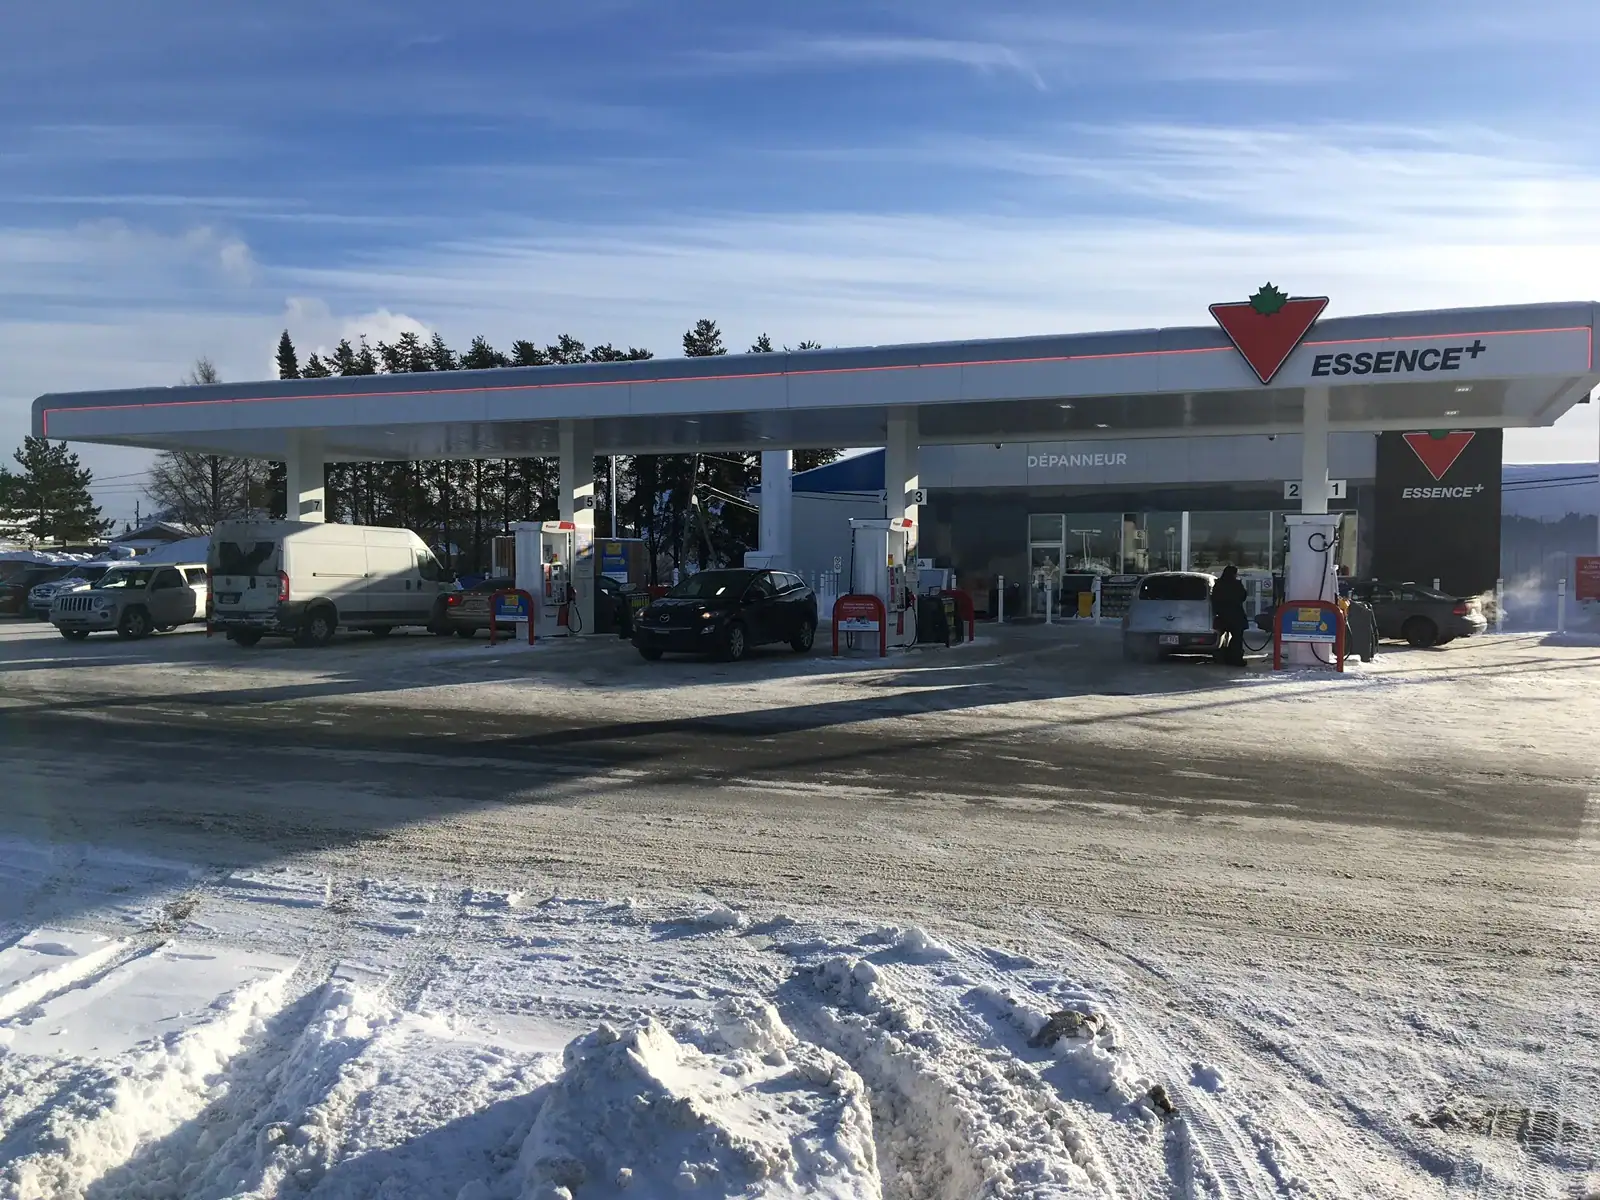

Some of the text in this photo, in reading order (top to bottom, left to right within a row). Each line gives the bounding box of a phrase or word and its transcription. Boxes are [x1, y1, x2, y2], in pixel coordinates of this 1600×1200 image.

[1027, 453, 1127, 468] DÉPANNEUR
[1289, 483, 1299, 497] 2
[1332, 482, 1339, 496] 1
[587, 496, 593, 507] 5
[915, 491, 923, 503] 3
[314, 500, 320, 510] 7
